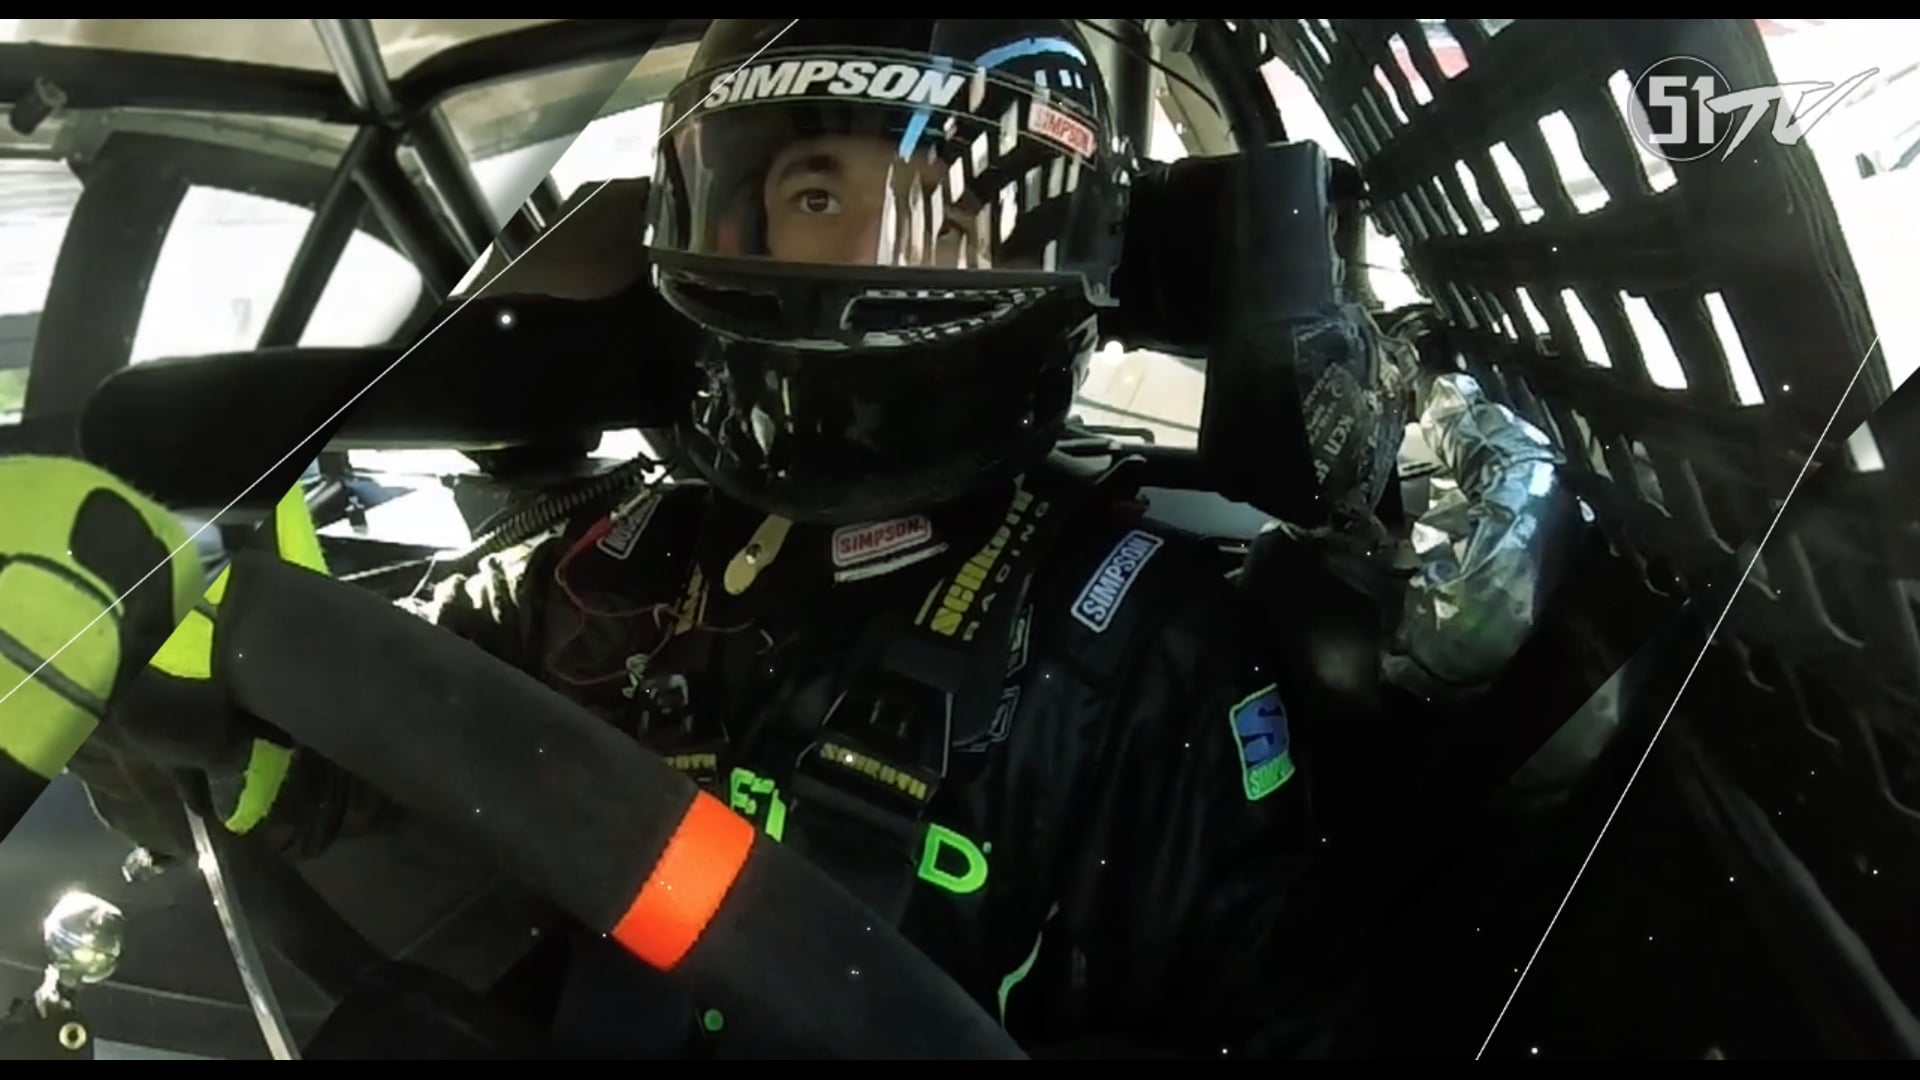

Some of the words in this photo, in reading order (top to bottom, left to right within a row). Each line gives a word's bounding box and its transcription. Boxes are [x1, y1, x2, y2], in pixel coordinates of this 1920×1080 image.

[704, 60, 966, 108] SIMPSON
[1034, 108, 1090, 153] SIMPSON
[840, 518, 920, 555] SIMPSON
[961, 501, 1050, 642] RACING
[1082, 536, 1151, 623] SIMPSON
